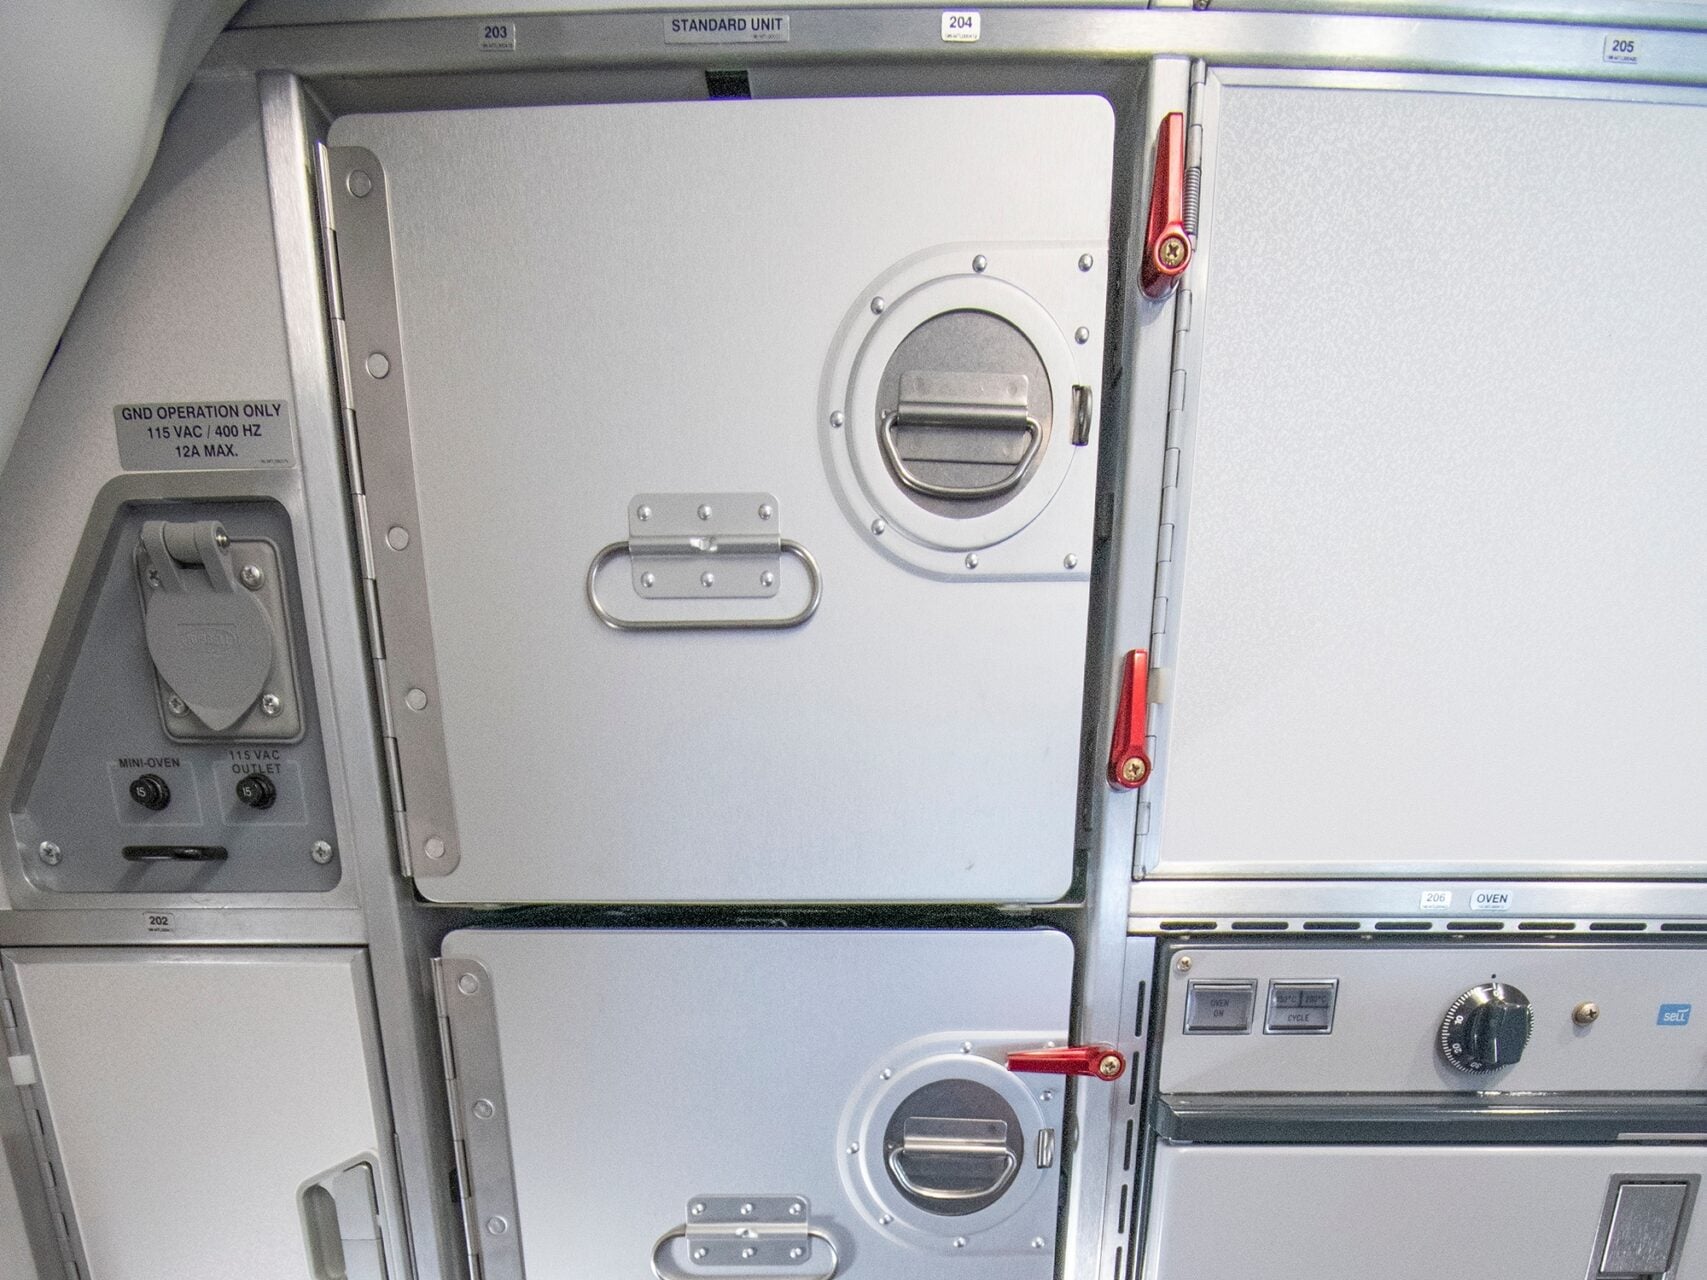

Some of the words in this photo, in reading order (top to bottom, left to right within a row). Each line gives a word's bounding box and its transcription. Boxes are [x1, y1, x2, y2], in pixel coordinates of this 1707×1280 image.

[672, 18, 747, 32] STANDARD
[751, 17, 783, 31] UNIT
[950, 16, 972, 28] 204
[485, 26, 507, 38] 203
[1612, 40, 1635, 53] 205
[121, 407, 153, 420] GND
[156, 404, 239, 419] OPERATION
[243, 403, 282, 417] ONLY
[147, 427, 171, 439] 115
[173, 425, 203, 438] VAC
[206, 425, 211, 438] /
[215, 425, 239, 437] 400
[243, 424, 262, 437] HZ
[175, 446, 200, 458] 12A
[204, 444, 239, 458] MAX.
[230, 750, 250, 761] 115
[252, 750, 281, 760] VAC
[118, 757, 181, 769] MINI-OVEN
[232, 763, 281, 774] OUTLET
[136, 786, 147, 798] 15
[242, 786, 252, 797] 15
[1426, 892, 1446, 902] 206
[1476, 893, 1509, 904] OVEN
[149, 916, 168, 925] 202
[1210, 999, 1230, 1007] OVEN
[1287, 1014, 1310, 1022] CYCLE
